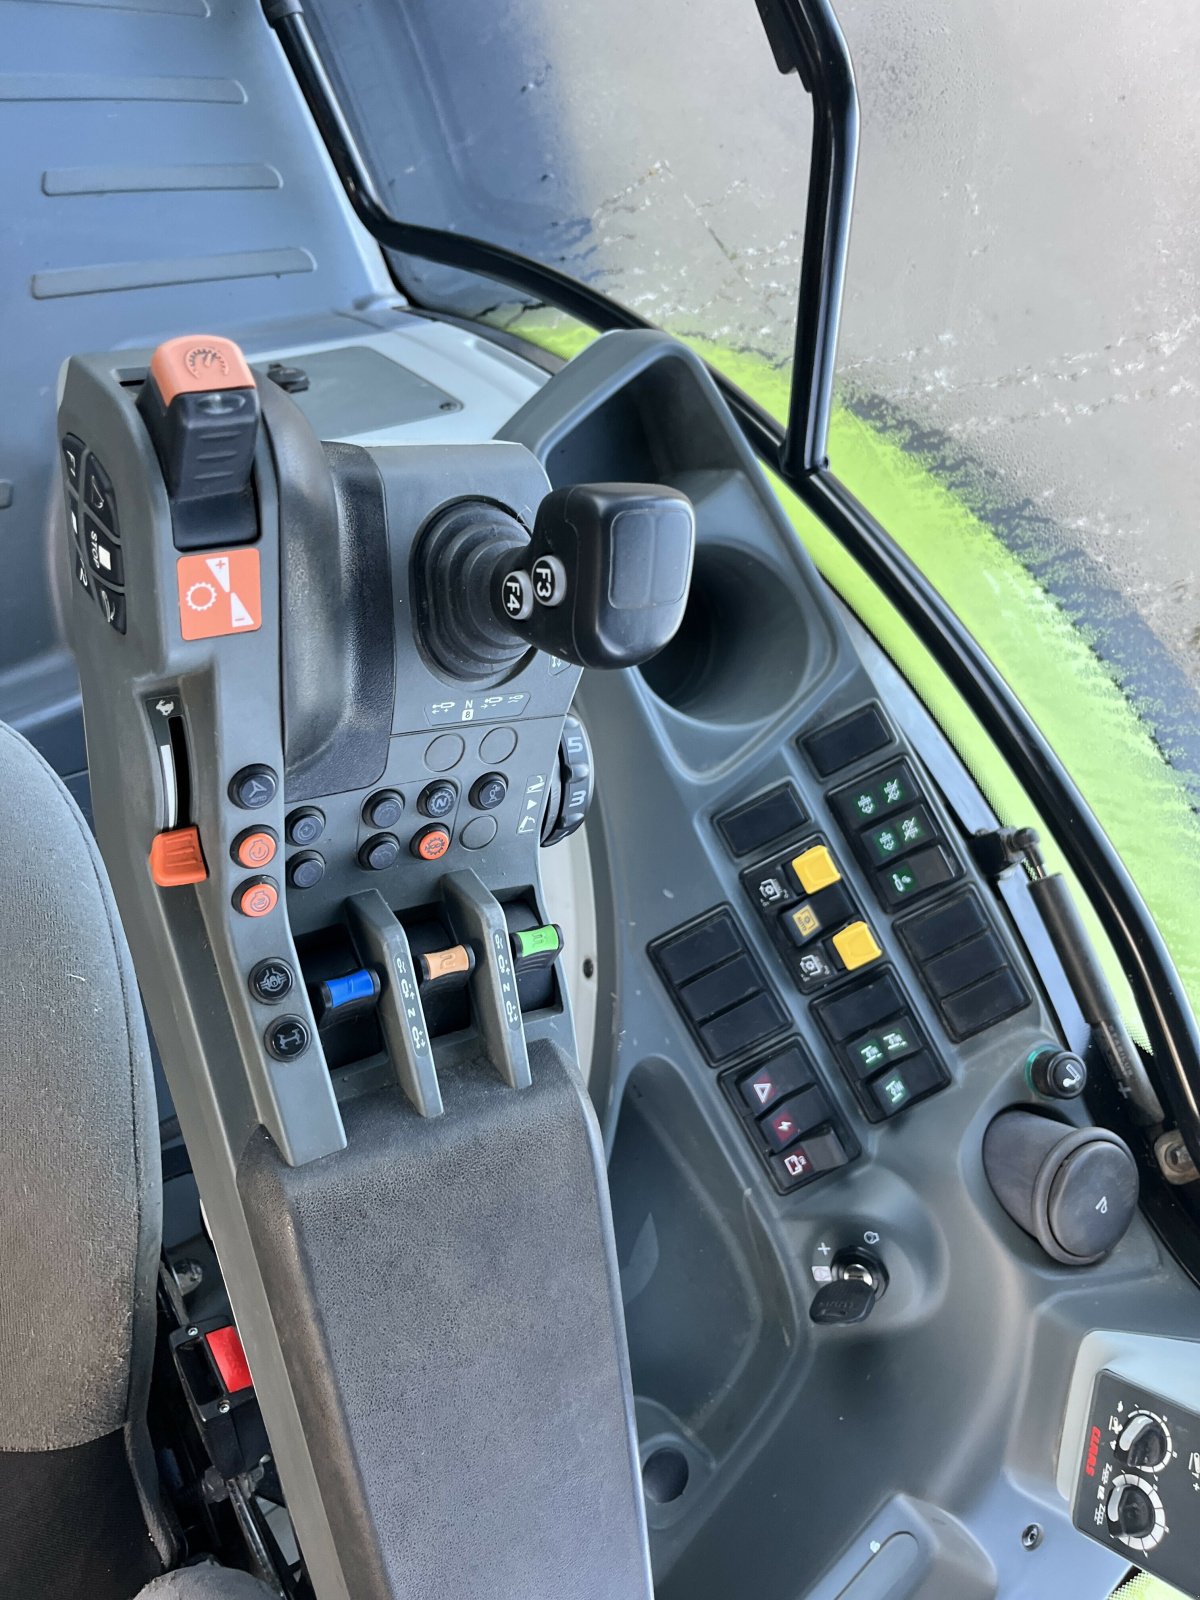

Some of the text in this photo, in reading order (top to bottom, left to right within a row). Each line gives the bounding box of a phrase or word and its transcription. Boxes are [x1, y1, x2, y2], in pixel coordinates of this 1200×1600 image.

[90, 530, 100, 569] STOP
[506, 581, 520, 611] F4
[535, 567, 552, 598] F3
[465, 699, 473, 709] N
[567, 736, 583, 753] 5
[568, 790, 587, 808] 3
[1085, 1425, 1102, 1477] CLAAS
